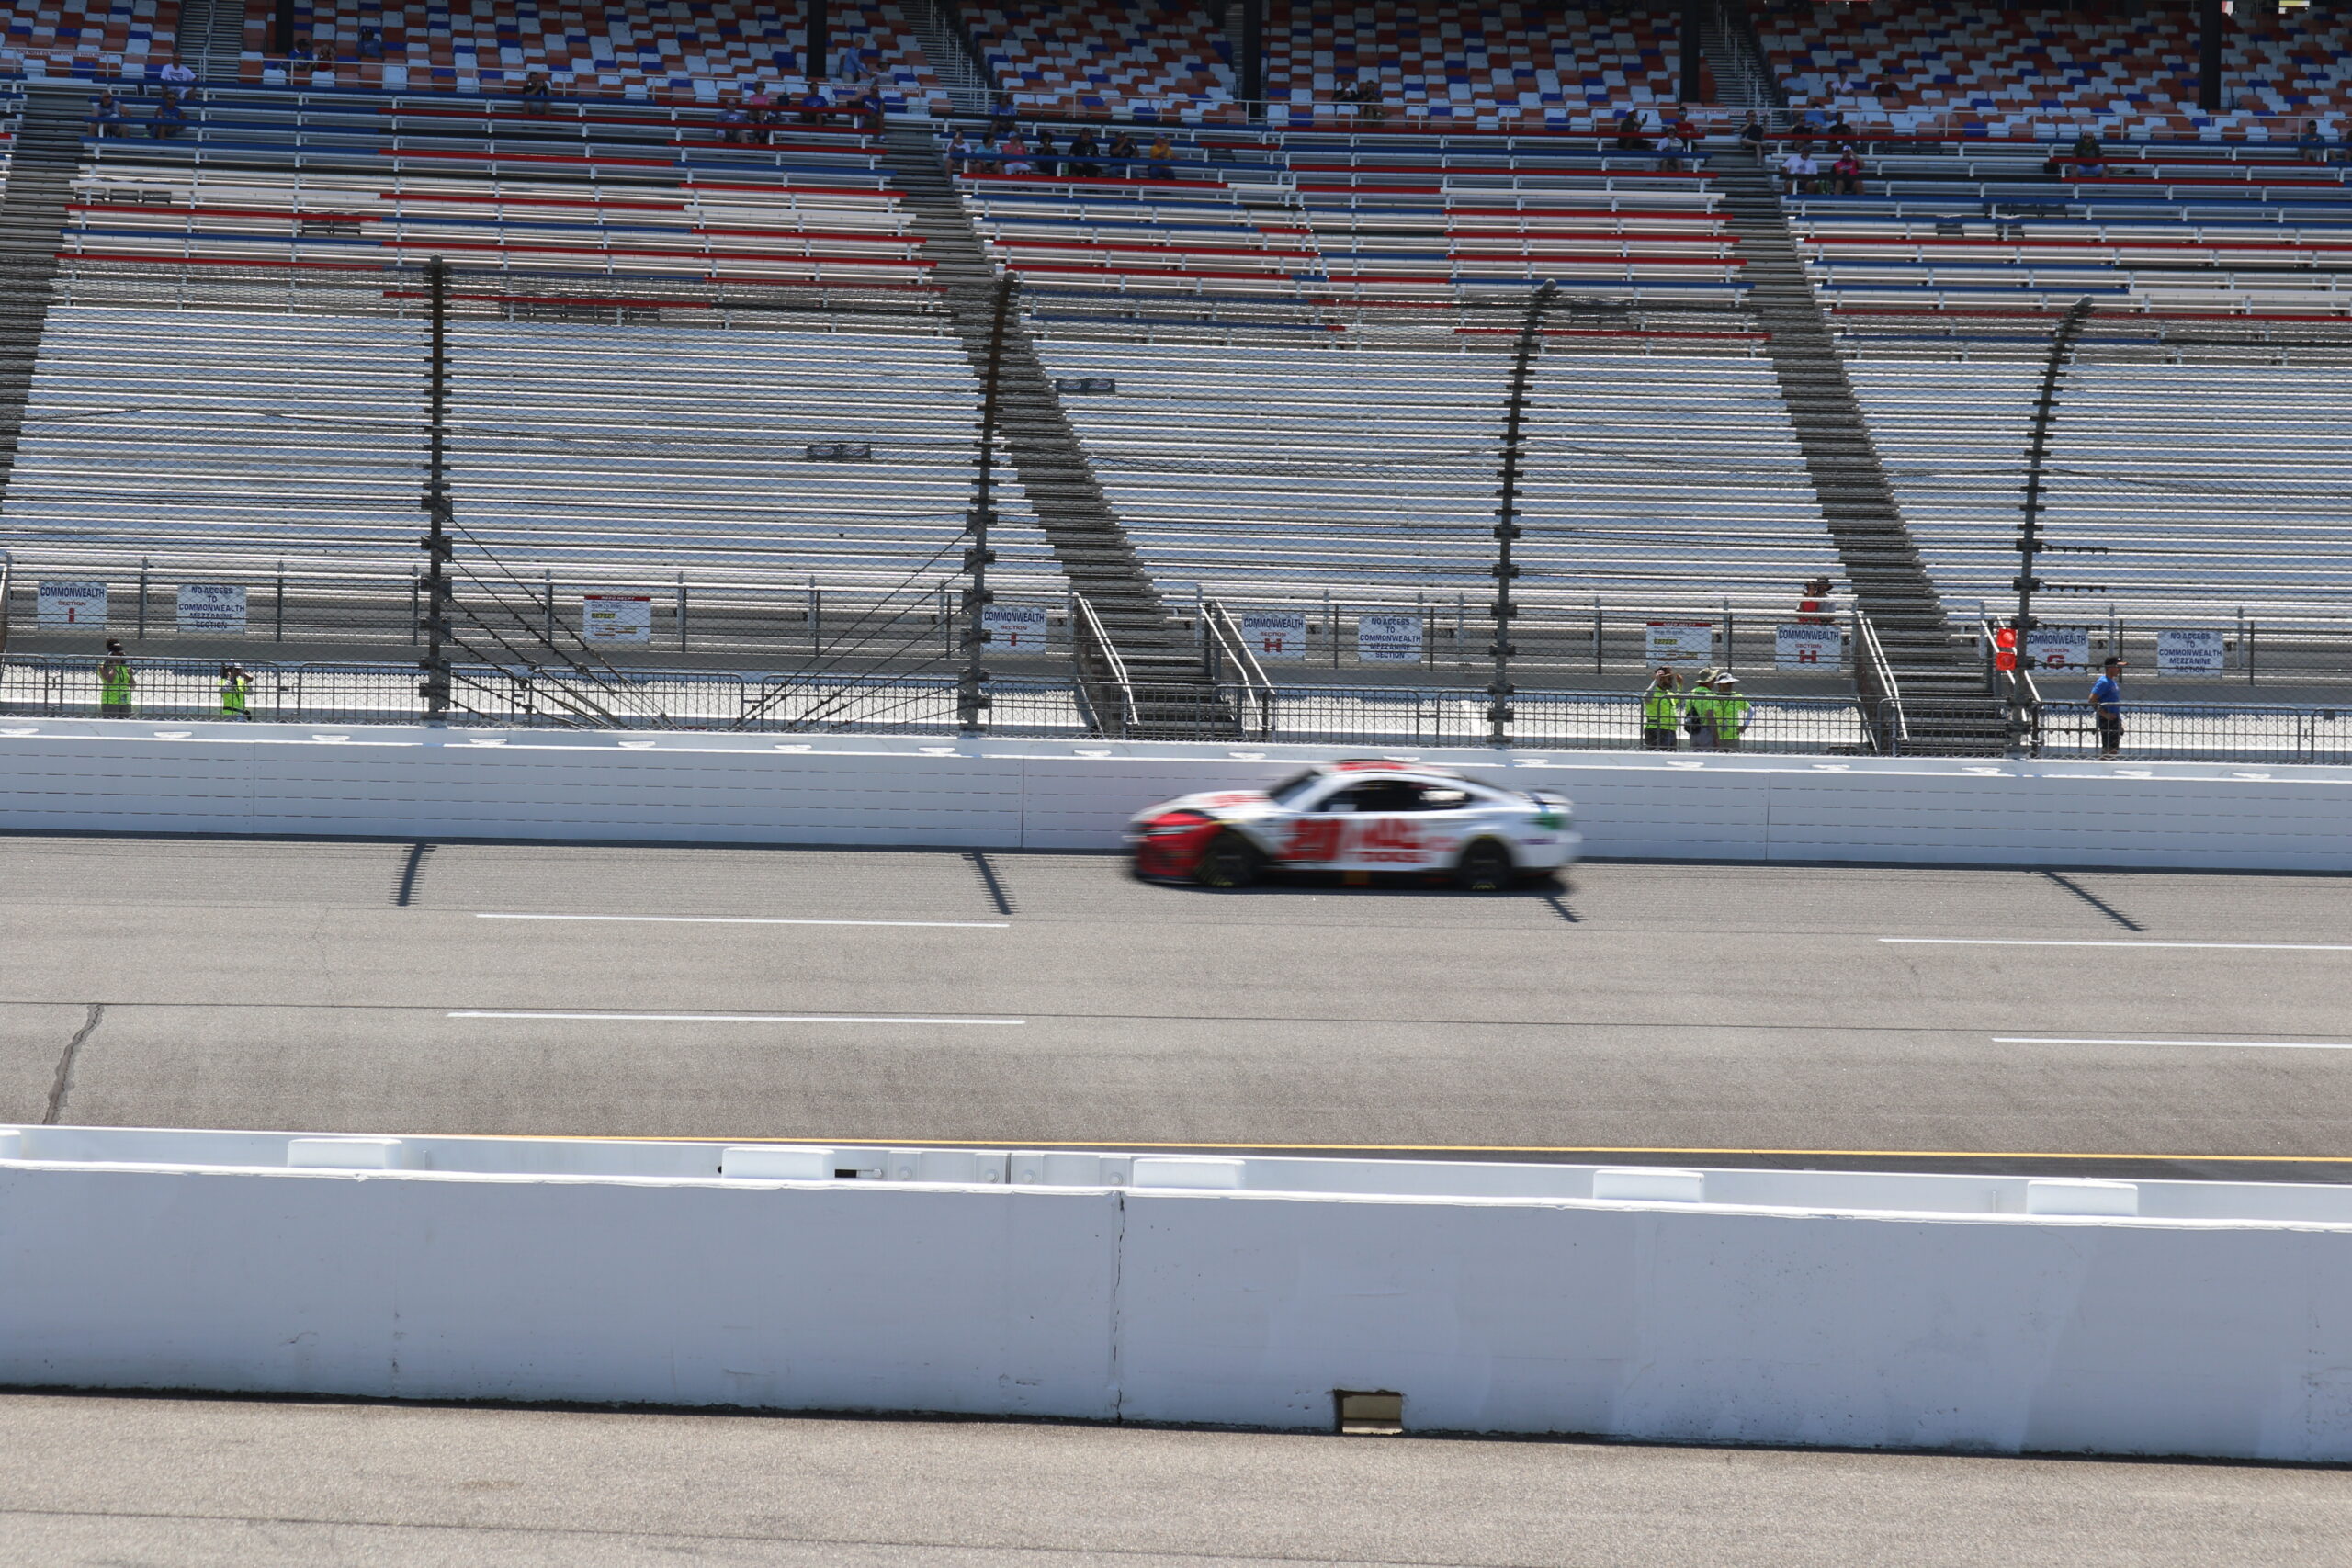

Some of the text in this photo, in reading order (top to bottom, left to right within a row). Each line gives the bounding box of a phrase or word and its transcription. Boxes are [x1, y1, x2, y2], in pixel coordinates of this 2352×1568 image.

[40, 587, 104, 597] COMMONWEALTH
[178, 604, 244, 612] COMMONWEALTH
[69, 607, 74, 623] I
[984, 611, 1045, 622] COMMONWEALTH
[196, 621, 228, 629] SECTION
[1244, 617, 1304, 628] COMMONWEALTH
[1011, 632, 1017, 647] I
[1360, 635, 1421, 643] COMMONWEALTH
[1779, 629, 1839, 640] COMMONWEALTH
[1264, 638, 1282, 653] H
[1799, 650, 1817, 664] H
[2047, 654, 2064, 669] G
